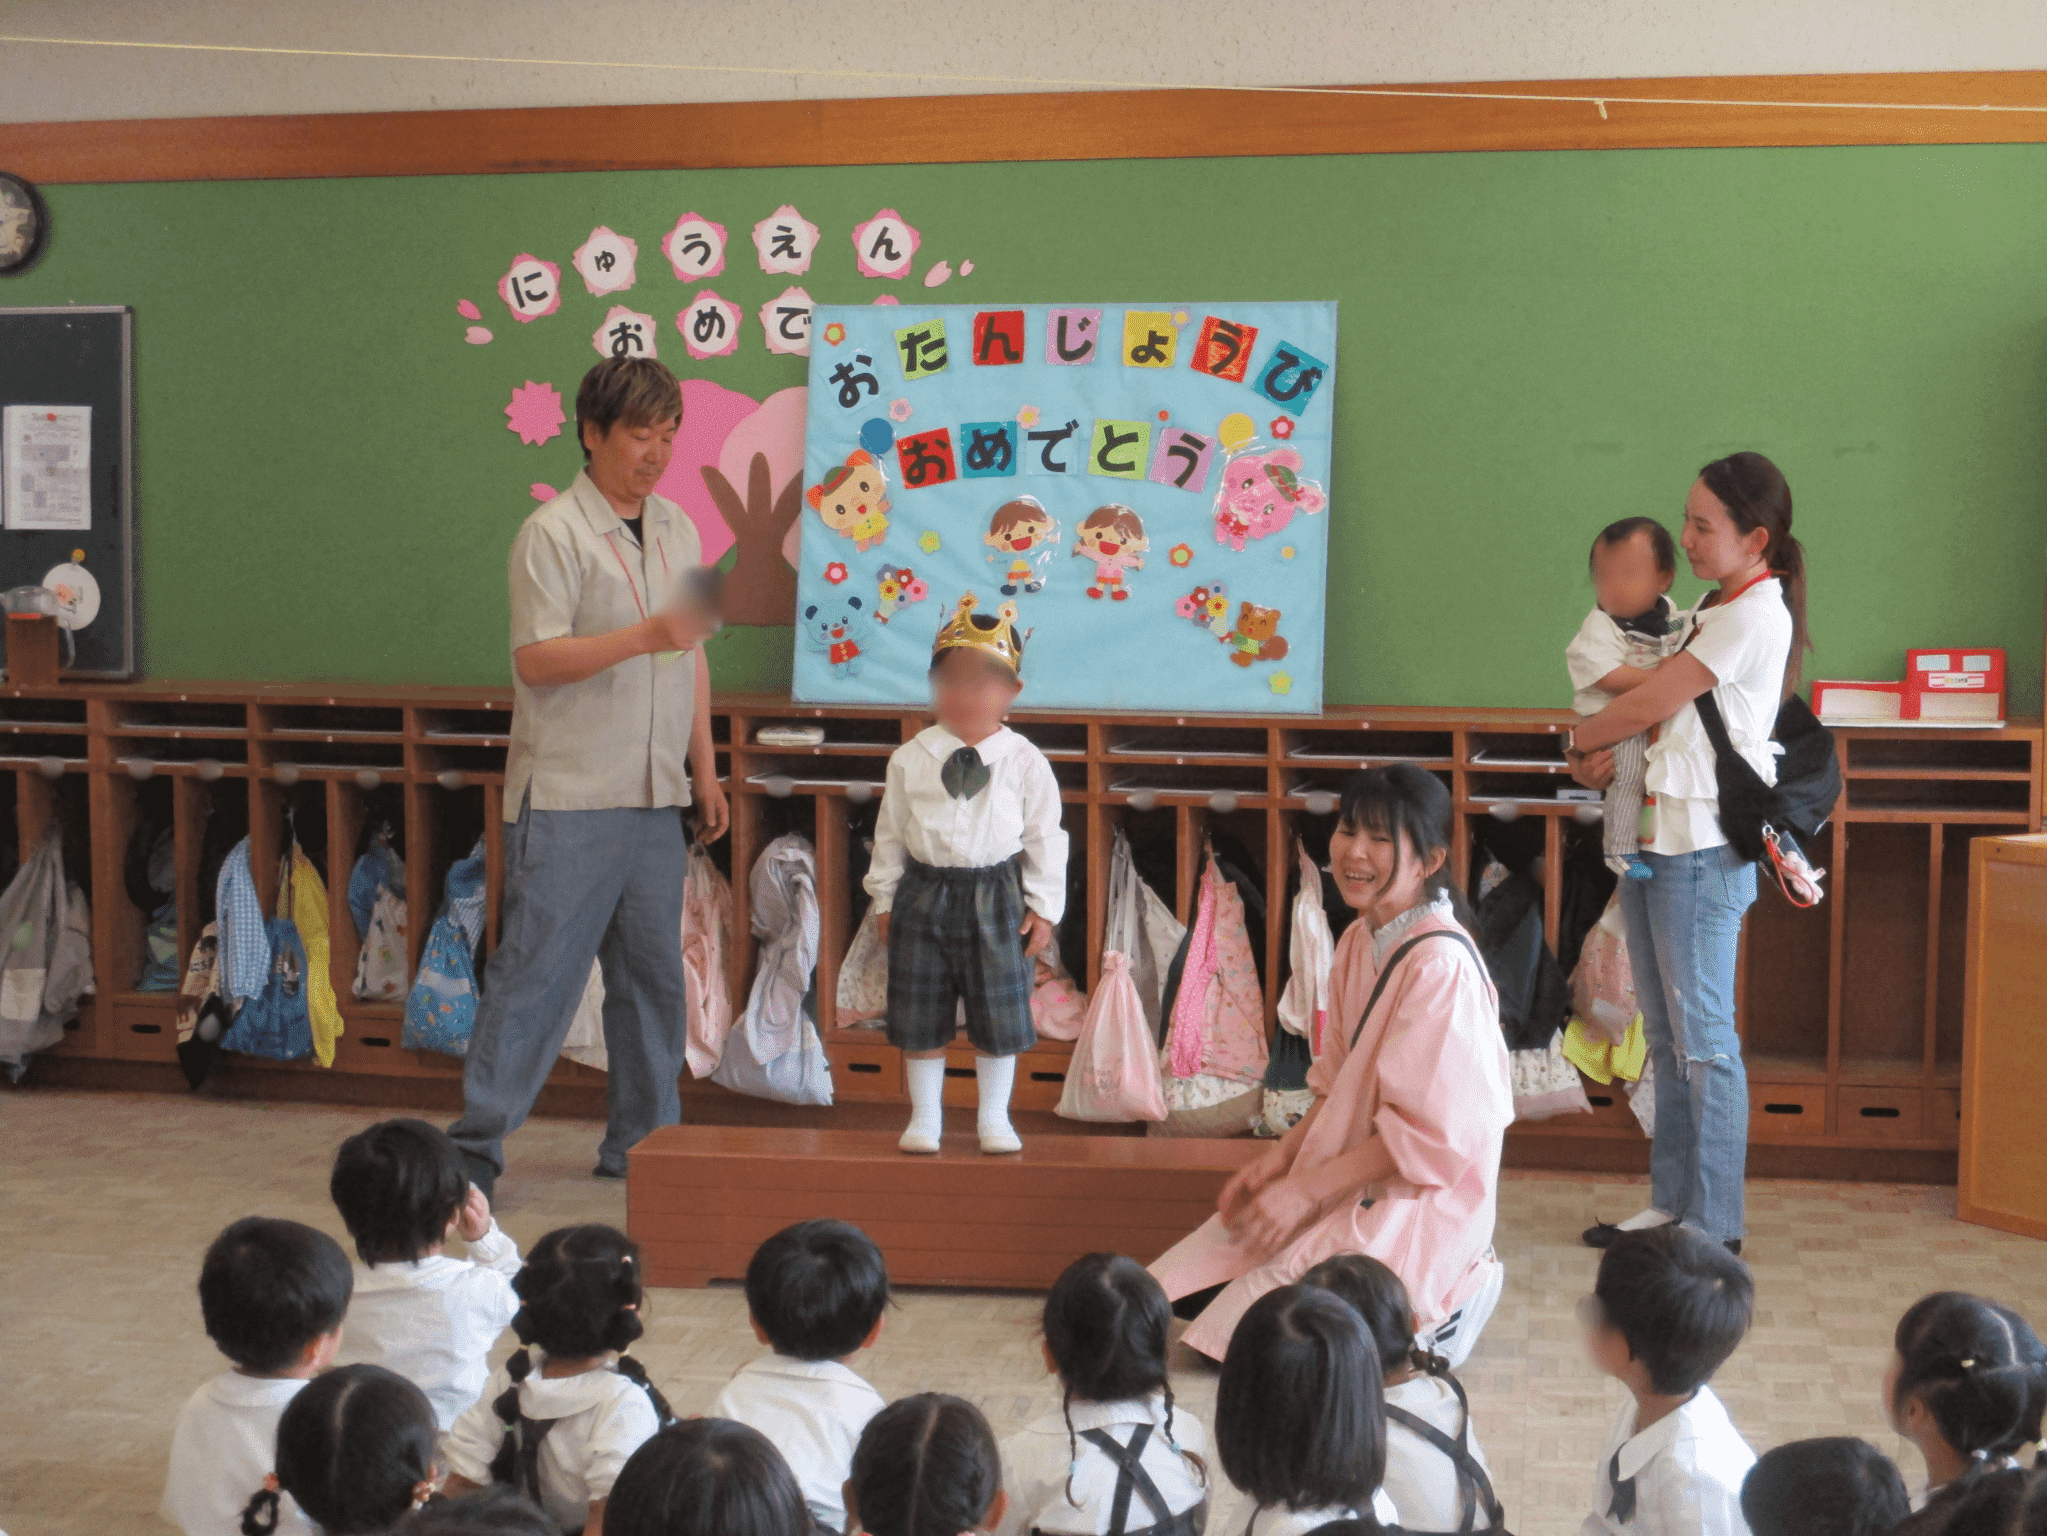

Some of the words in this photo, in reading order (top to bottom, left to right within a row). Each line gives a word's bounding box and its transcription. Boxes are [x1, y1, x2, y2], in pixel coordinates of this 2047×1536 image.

[511, 226, 902, 309] にゅうえん
[828, 314, 1322, 409] おたんじょうび
[903, 418, 1207, 489] おめでとう
